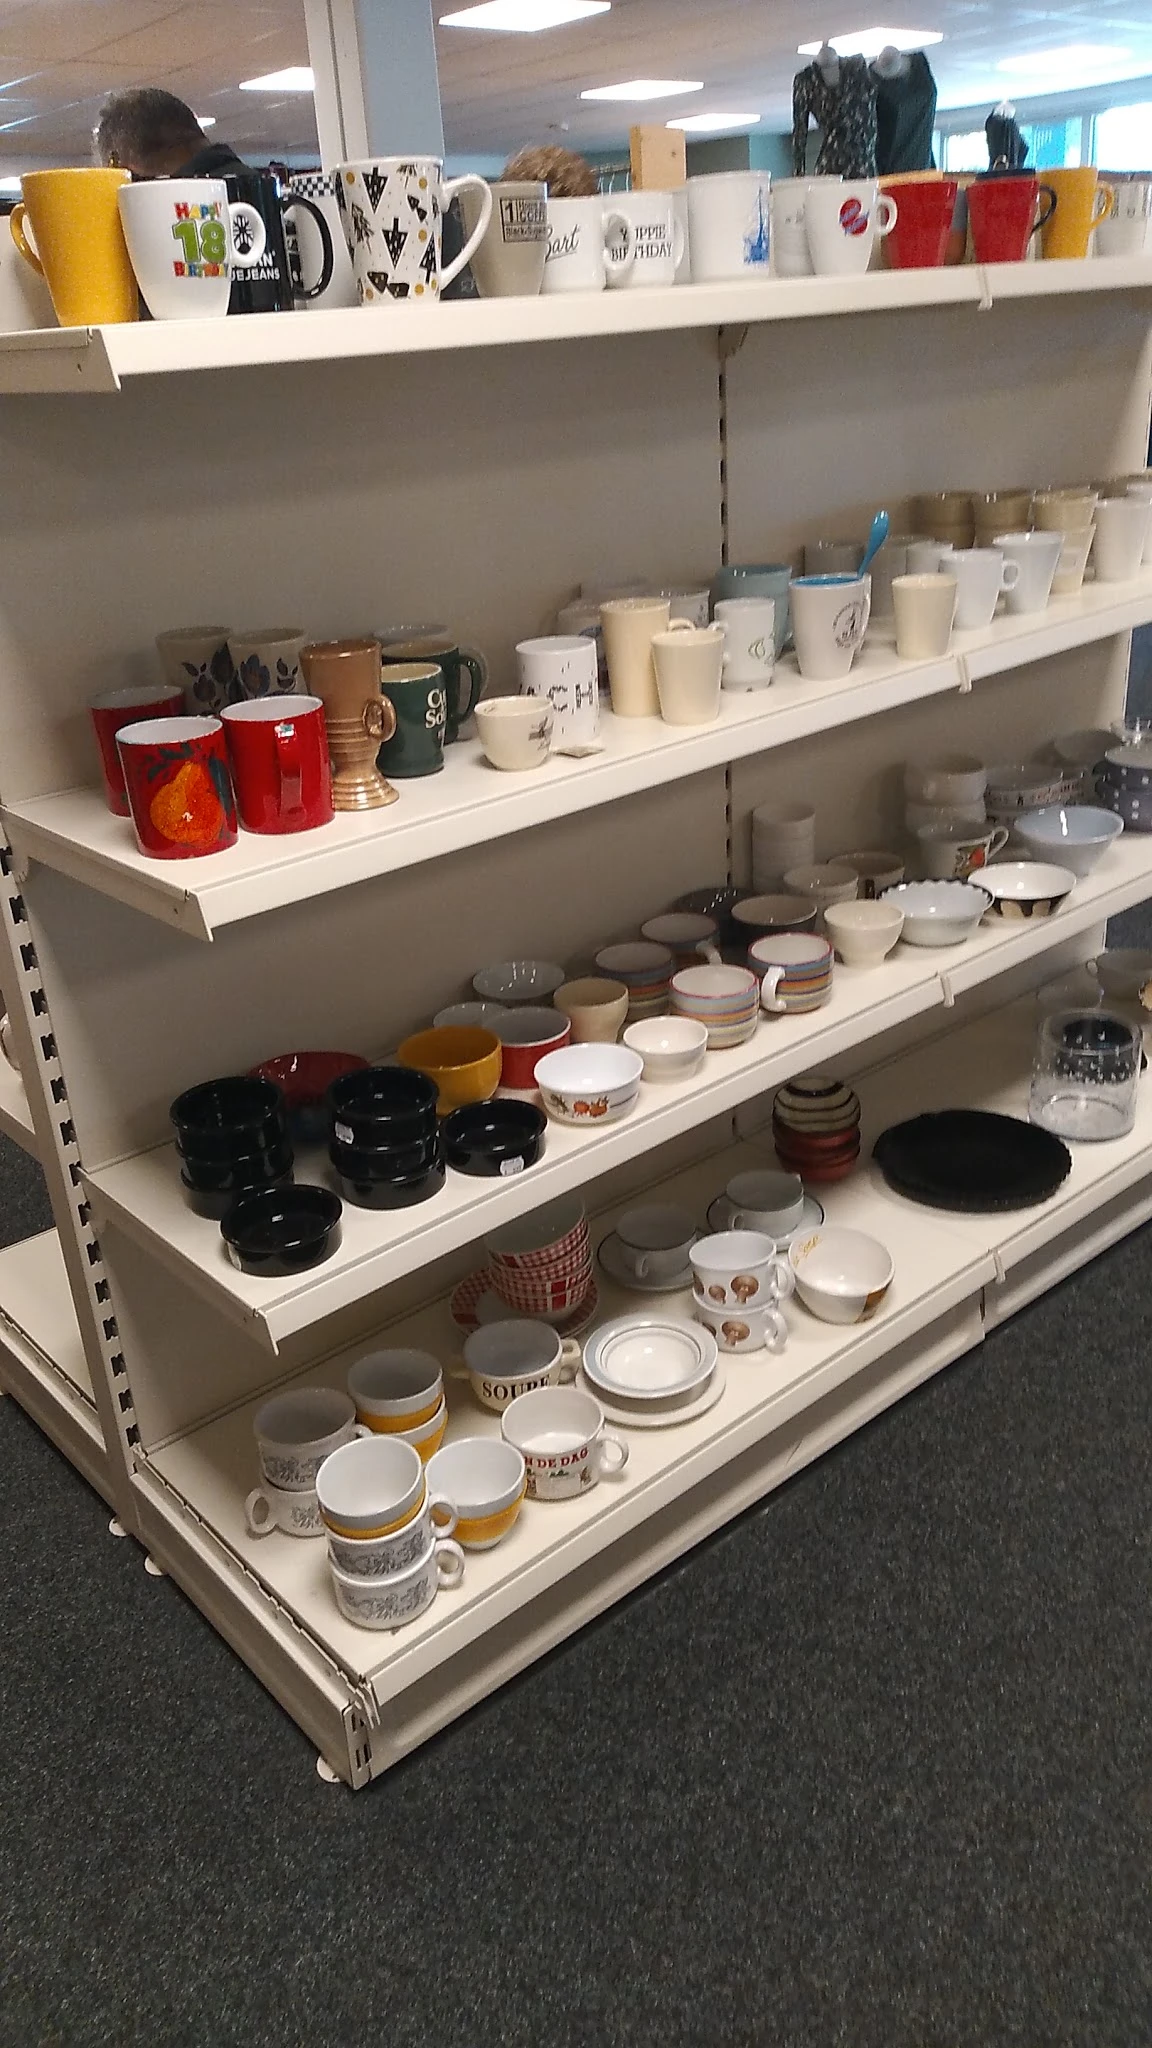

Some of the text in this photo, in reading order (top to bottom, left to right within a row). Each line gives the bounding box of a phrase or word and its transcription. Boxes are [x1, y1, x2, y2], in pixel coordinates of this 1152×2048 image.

[174, 202, 222, 219] HAPPY
[172, 219, 227, 264] 18
[173, 261, 230, 278] BIRTHDAY
[537, 1457, 557, 1469] DE
[561, 1446, 589, 1468] DAG
